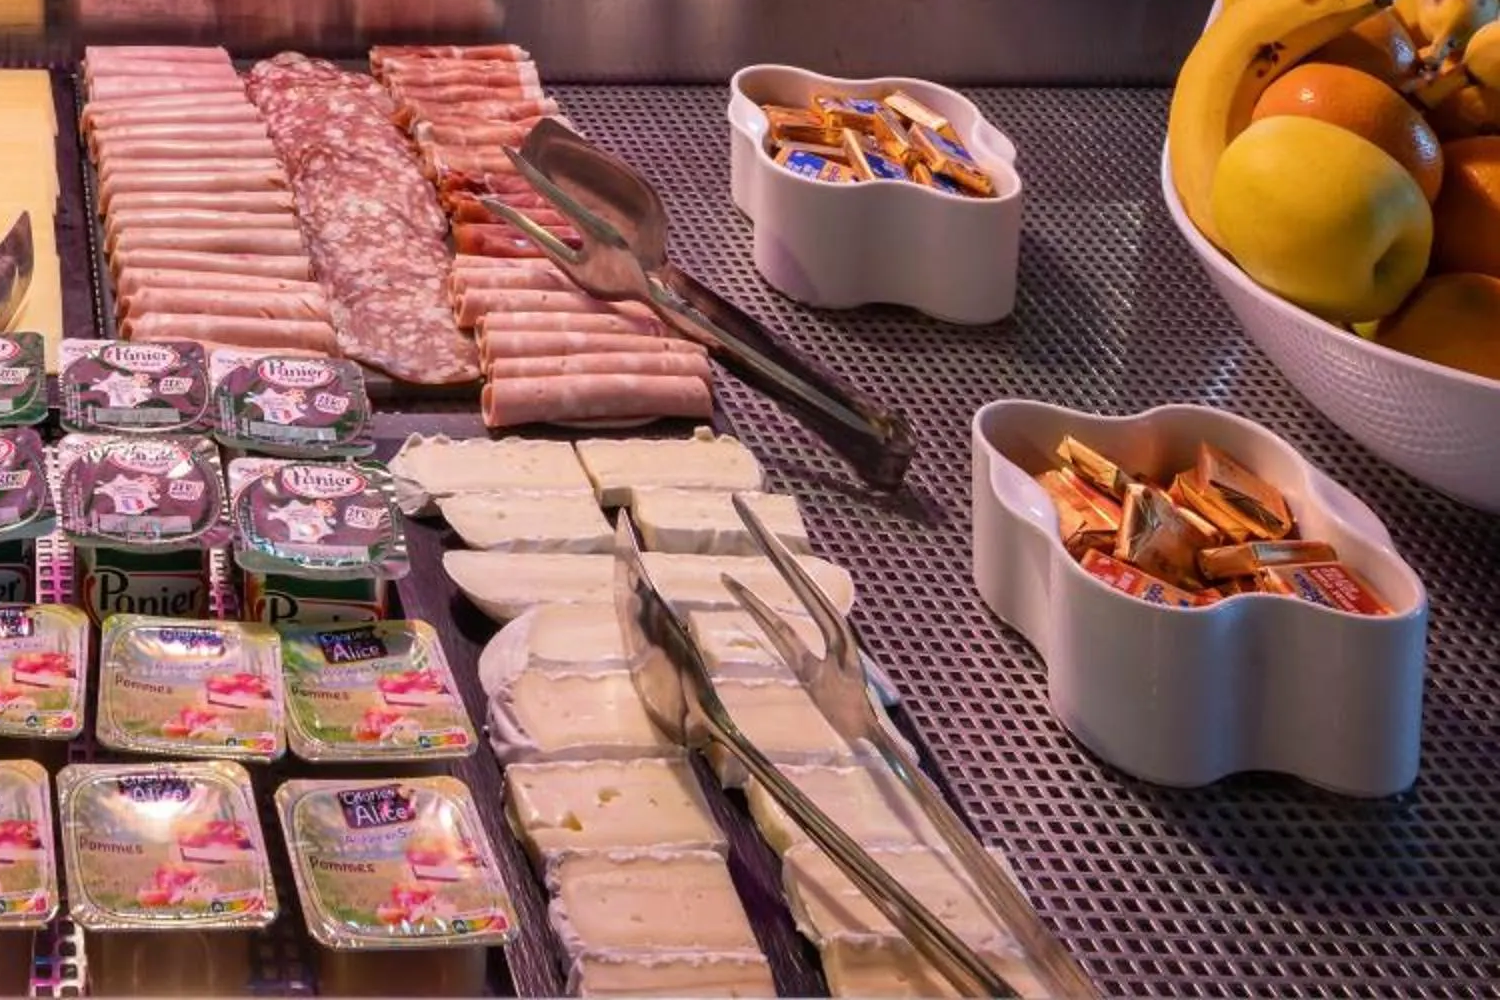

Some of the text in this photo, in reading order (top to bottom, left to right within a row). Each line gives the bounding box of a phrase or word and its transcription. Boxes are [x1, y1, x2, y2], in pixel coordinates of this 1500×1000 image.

[292, 467, 356, 486] Panier
[332, 642, 381, 662] Alice
[354, 805, 410, 827] Alice
[79, 836, 144, 855] Pommes
[309, 856, 377, 873] Pommes
